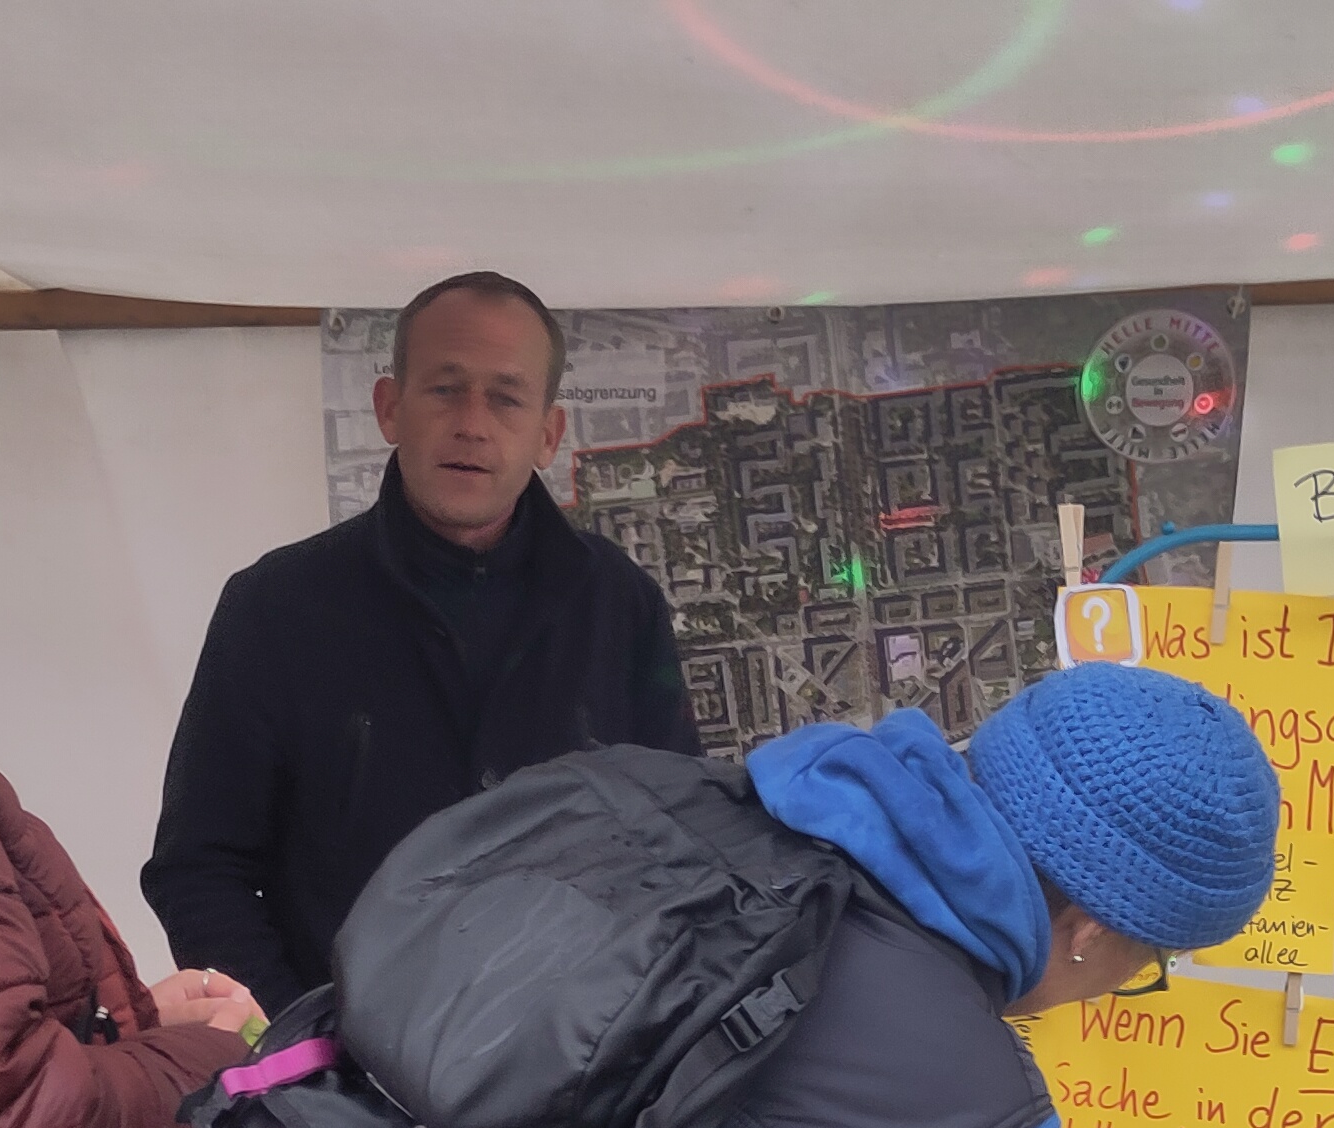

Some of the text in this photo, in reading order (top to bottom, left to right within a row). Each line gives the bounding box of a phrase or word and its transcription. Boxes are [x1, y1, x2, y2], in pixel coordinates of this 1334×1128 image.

[558, 385, 656, 402] sabgrenzung
[1141, 605, 1211, 660] Was
[1240, 605, 1295, 660] ist
[1244, 939, 1309, 967] allee
[1078, 996, 1187, 1048] Wenn
[1204, 999, 1273, 1059] Sie
[1195, 1088, 1227, 1123] in
